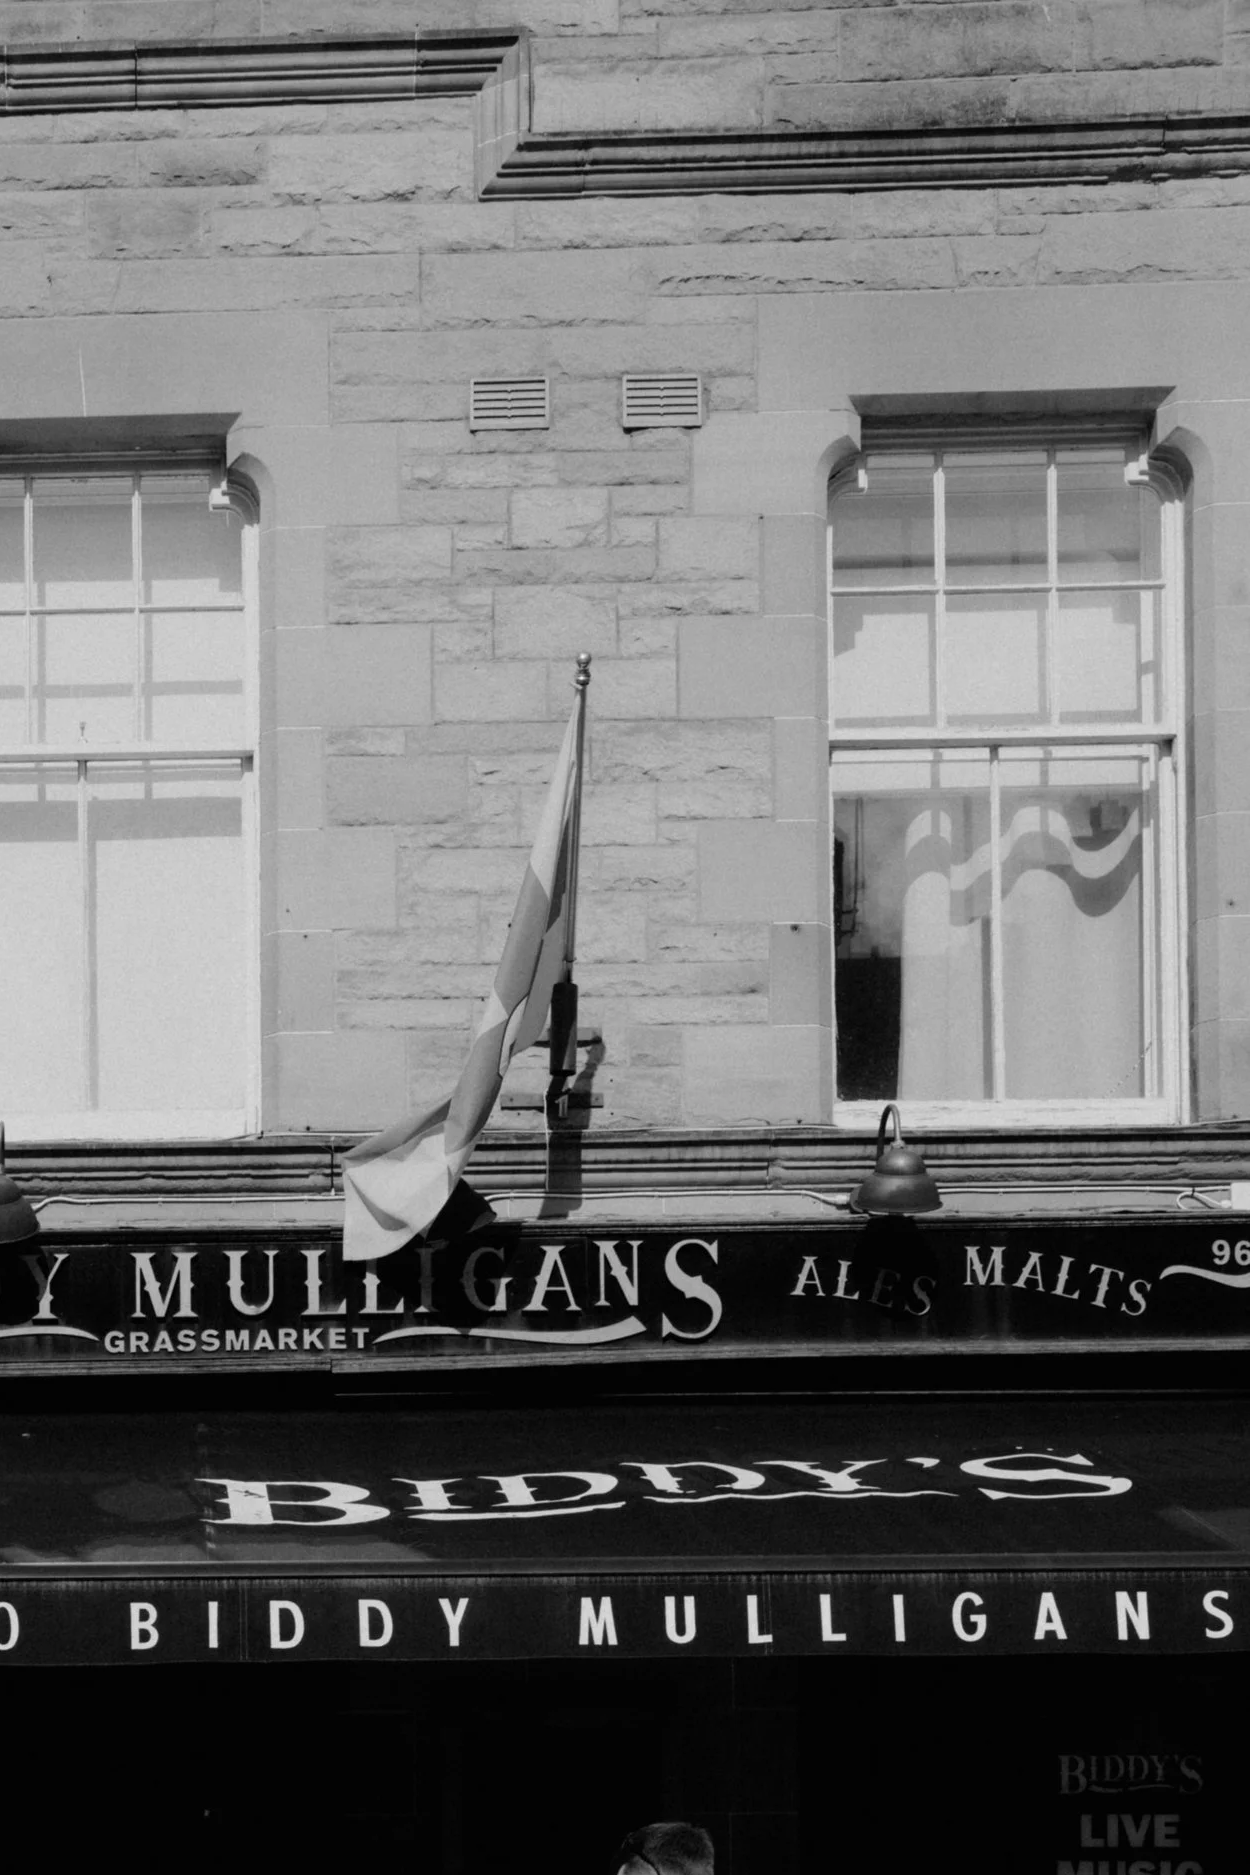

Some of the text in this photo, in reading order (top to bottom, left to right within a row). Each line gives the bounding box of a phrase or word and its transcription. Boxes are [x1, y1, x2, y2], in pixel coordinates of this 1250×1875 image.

[1211, 1239, 1250, 1266] 96
[130, 1238, 724, 1342] MULLIGANS
[790, 1245, 1153, 1317] ALES MALTS
[104, 1326, 371, 1355] GRASSMARKET
[195, 1452, 1133, 1526] BIDDY'S
[129, 1597, 470, 1650] BIDDY
[578, 1589, 1235, 1646] MULLIGANS
[1057, 1754, 1204, 1795] BIDDY'S
[1080, 1813, 1181, 1848] LIVE
